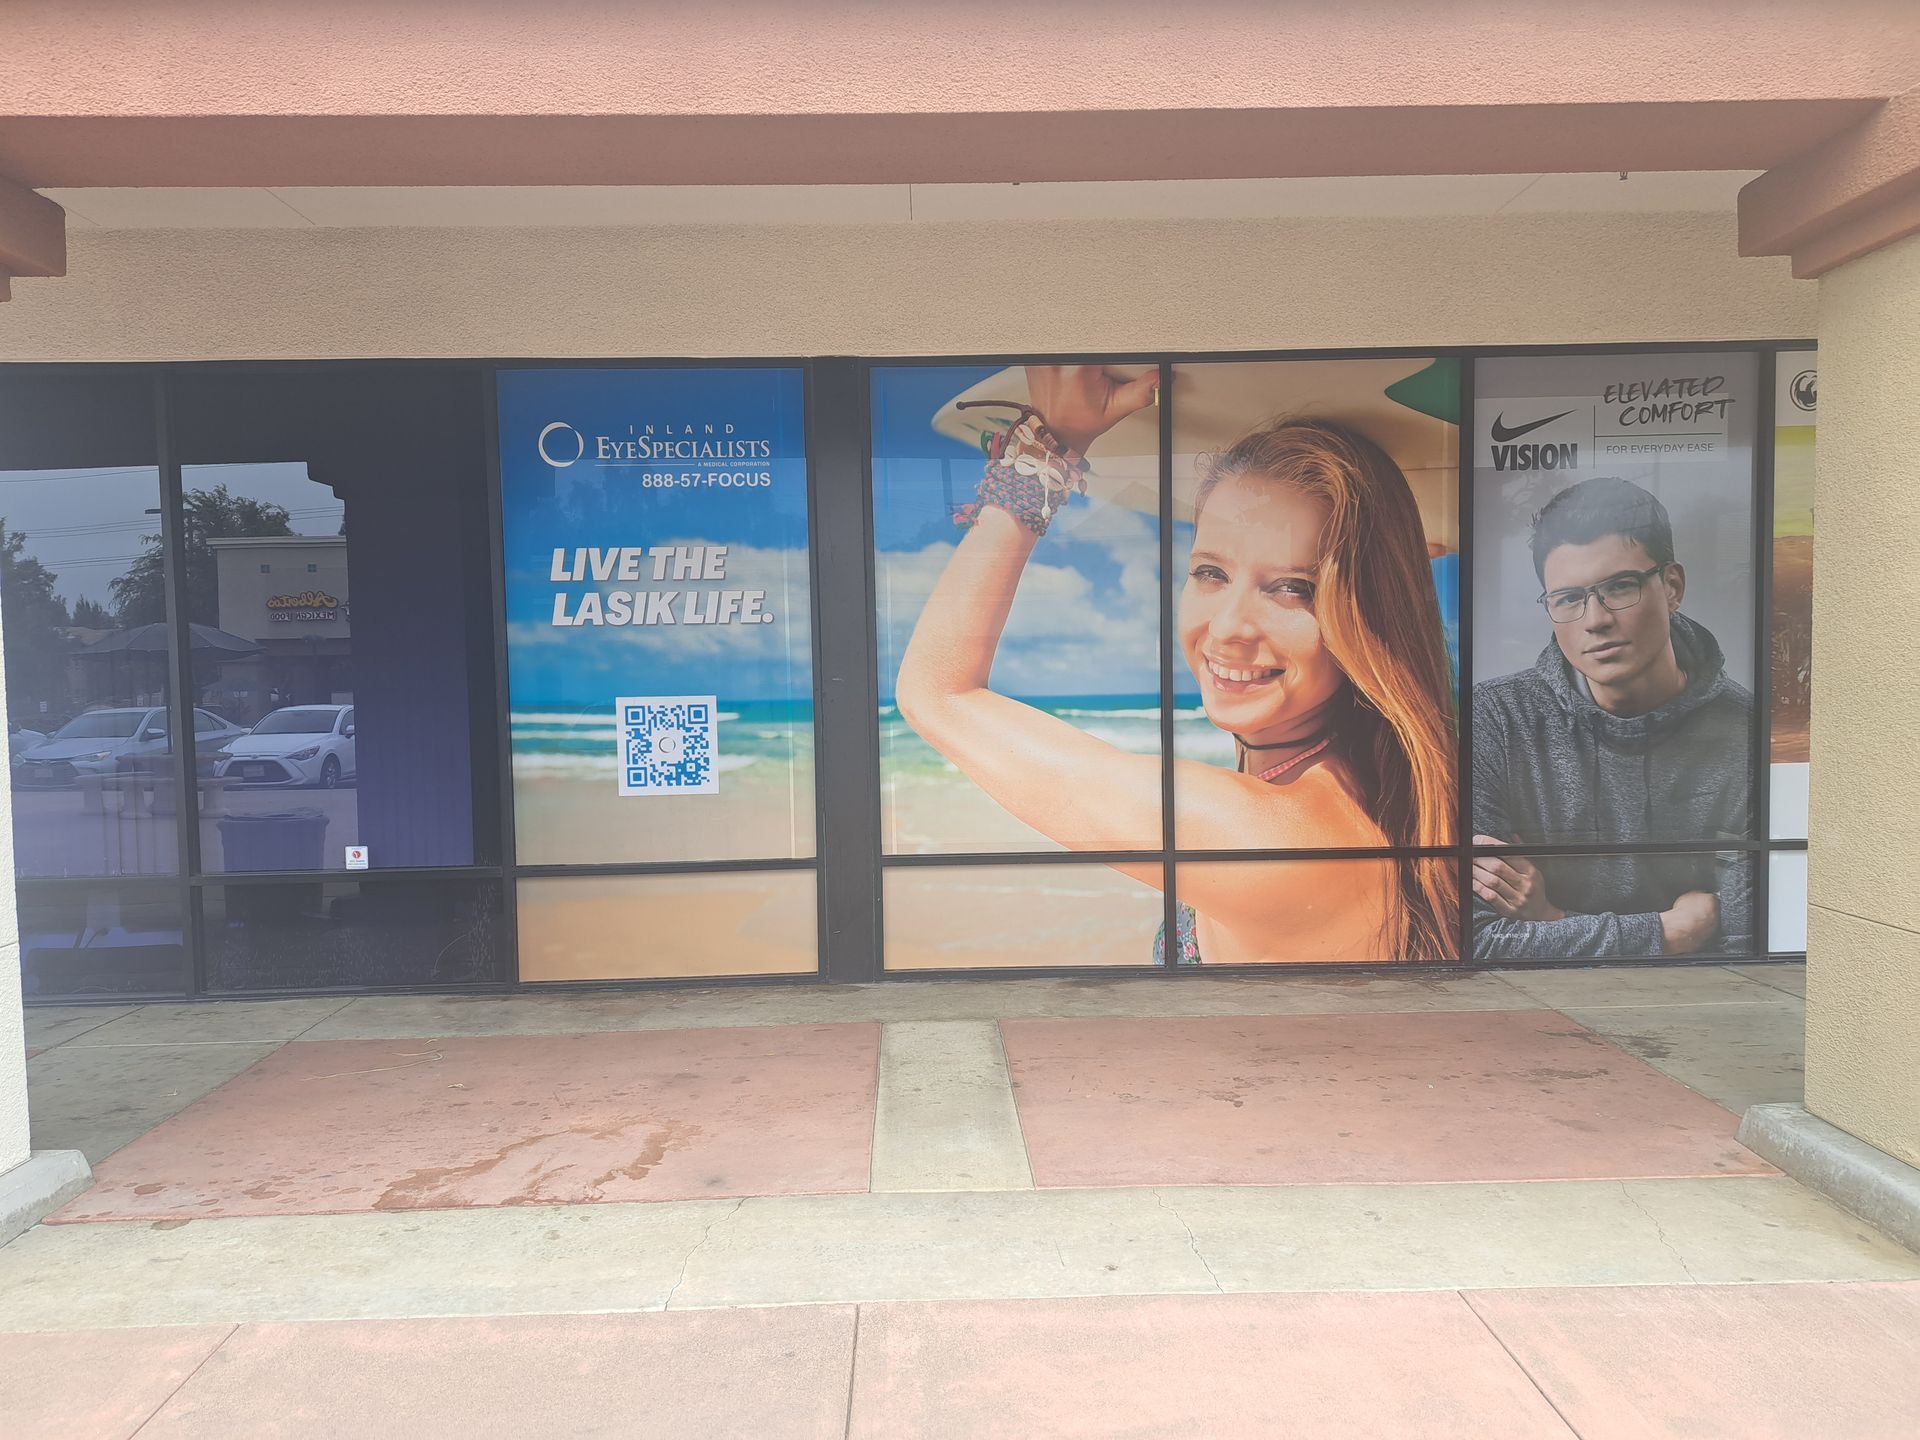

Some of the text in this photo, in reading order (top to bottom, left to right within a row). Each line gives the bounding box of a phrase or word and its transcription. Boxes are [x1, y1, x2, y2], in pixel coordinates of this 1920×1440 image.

[1603, 375, 1726, 404] ELEVATED
[1619, 398, 1736, 427] COMFORT
[629, 424, 734, 435] INLAND
[1491, 443, 1577, 471] VISION
[1606, 443, 1713, 454] FOR EVERYDAY EASE
[642, 472, 771, 488] 888-57-FOCUS
[550, 546, 728, 581] LIVE THE
[552, 590, 774, 626] LASIK LIFE.
